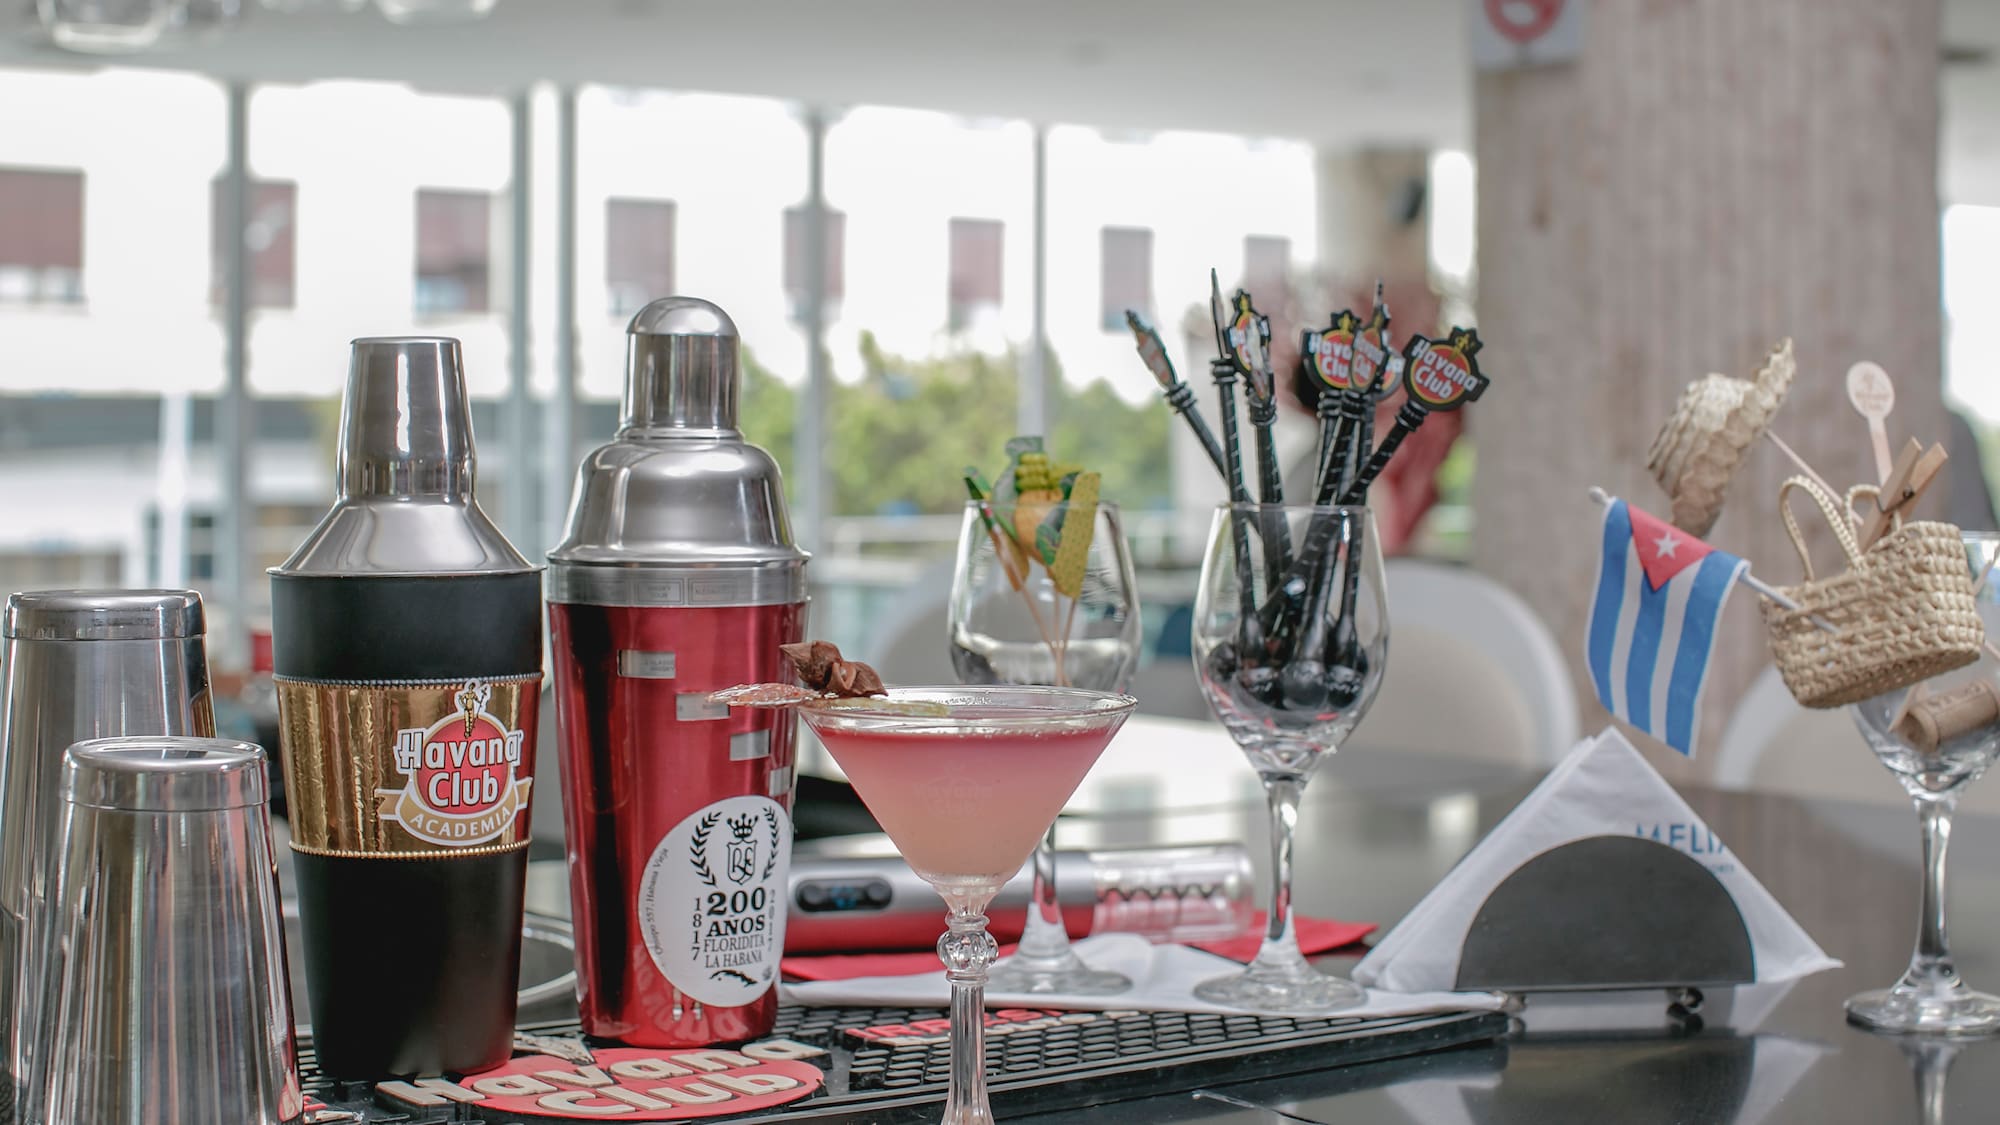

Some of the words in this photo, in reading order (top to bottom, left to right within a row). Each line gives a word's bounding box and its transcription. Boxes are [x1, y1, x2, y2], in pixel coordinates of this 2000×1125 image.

[1309, 333, 1353, 360] Hava
[1321, 356, 1348, 378] Clu
[1411, 339, 1480, 392] Havana
[1415, 366, 1453, 399] Club
[395, 731, 521, 769] Havana
[428, 769, 499, 807] Club
[410, 808, 511, 838] ACADEMIA
[707, 887, 766, 916] 200
[706, 914, 766, 937] AÑOS
[703, 934, 766, 953] FLORIDITA
[705, 955, 720, 969] LA
[723, 950, 763, 968] HABANA
[375, 1039, 829, 1105] Havana
[537, 1072, 799, 1115] Club
